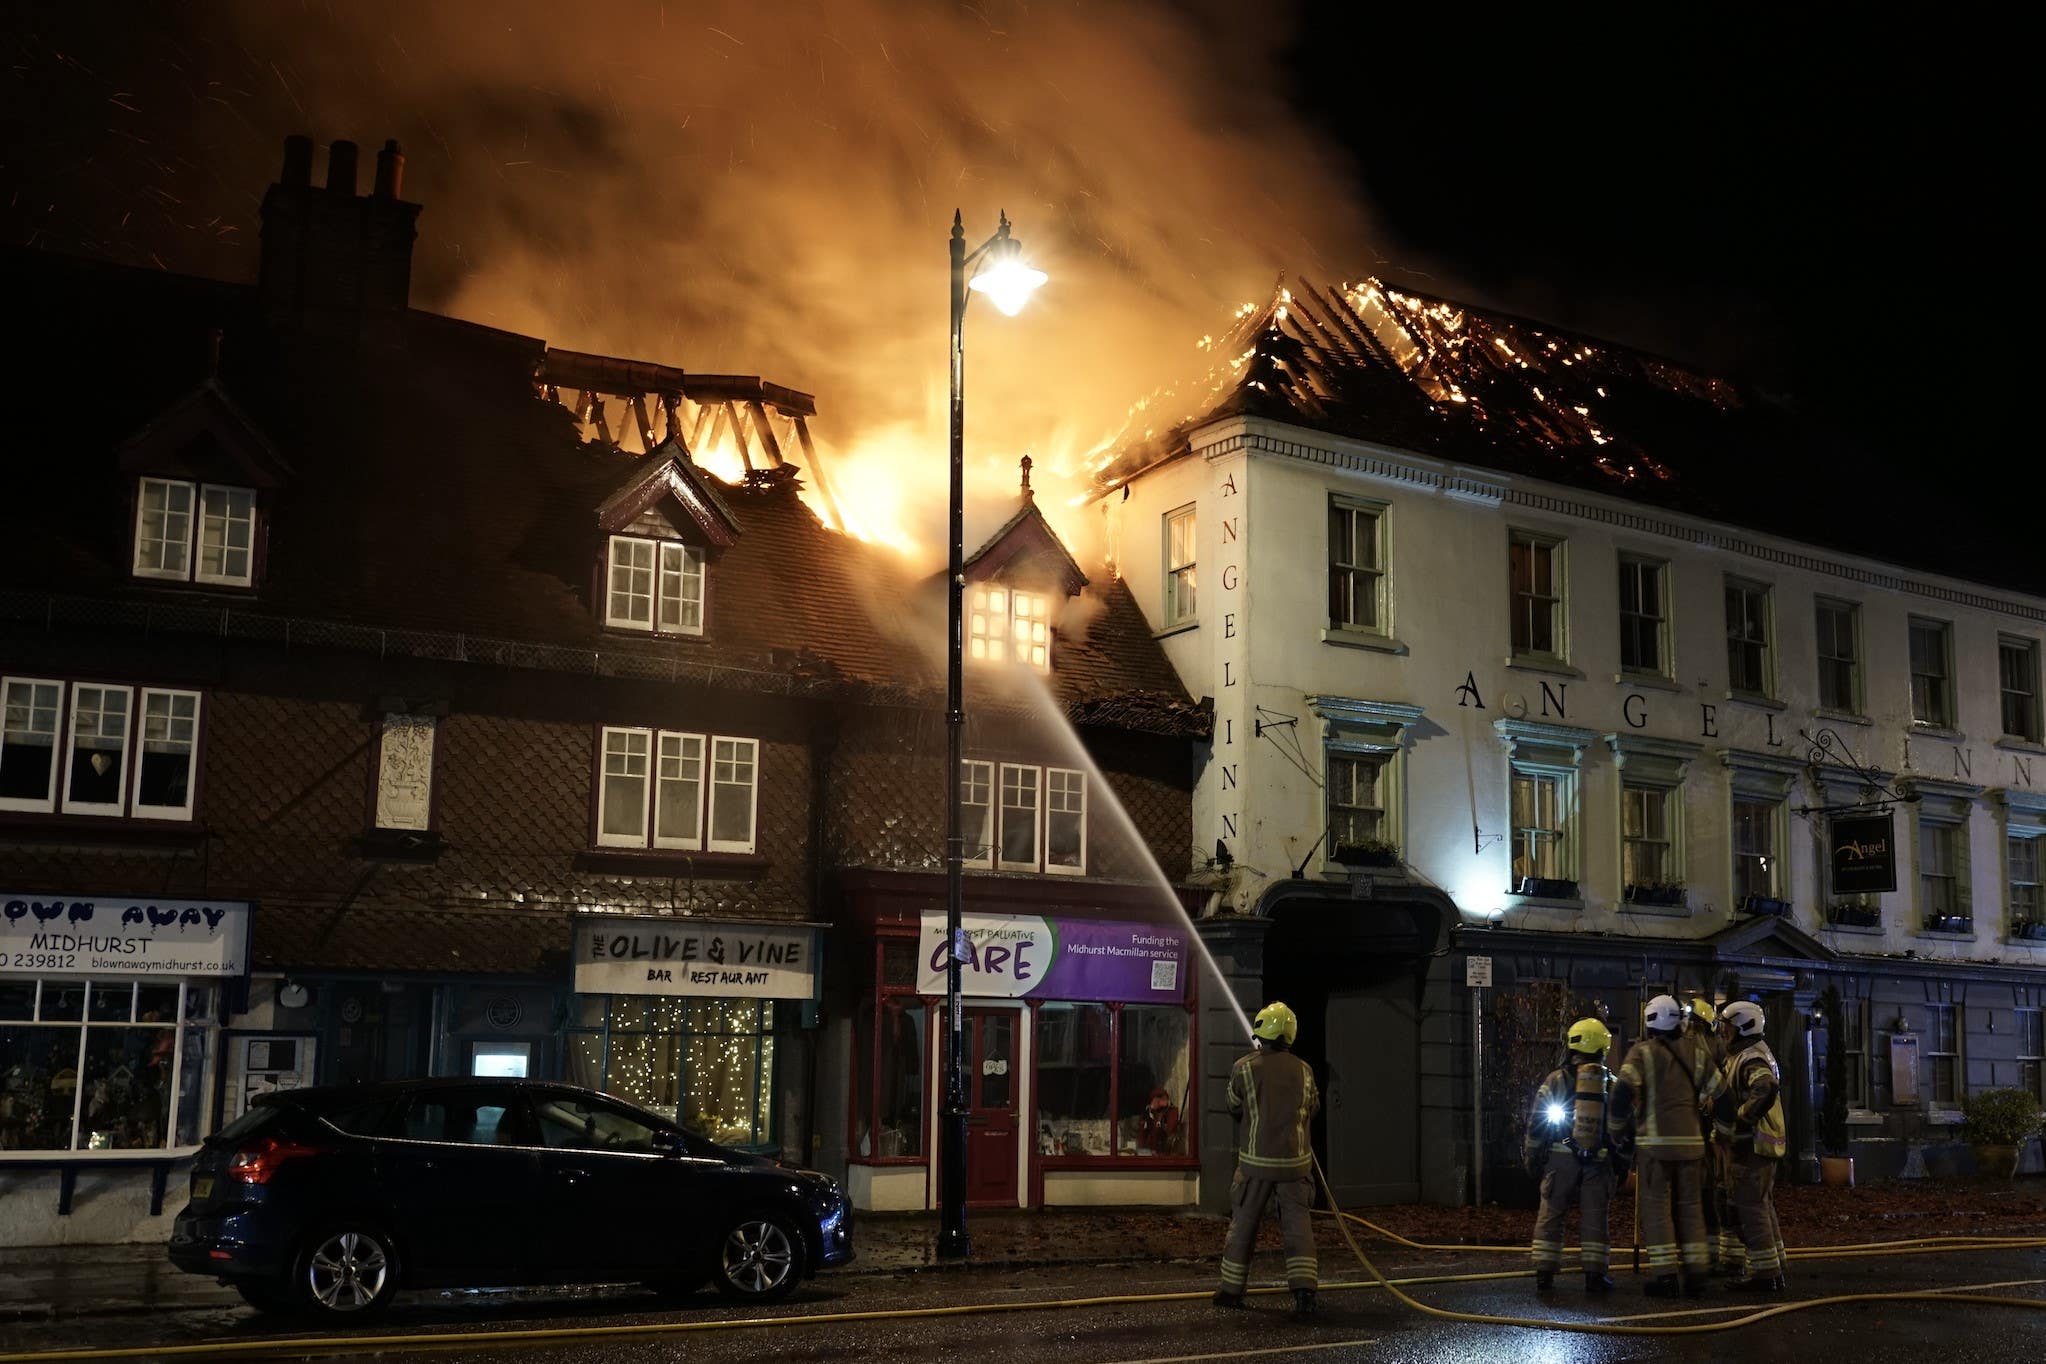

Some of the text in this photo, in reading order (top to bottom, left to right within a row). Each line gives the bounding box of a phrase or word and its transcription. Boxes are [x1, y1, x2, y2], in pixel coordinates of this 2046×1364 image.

[1222, 471, 1238, 840] ANGEL INN
[1455, 670, 2031, 787] ANGEL INN
[1834, 838, 1886, 860] Angel
[0, 899, 225, 929] OWN AWAY
[30, 933, 152, 953] MIDHURST
[593, 934, 605, 958] THE
[609, 935, 801, 965] OLIVE & VINE
[1067, 943, 1179, 959] Midhurst Macmillan service
[1132, 934, 1180, 947] Funding the
[14, 953, 75, 968] 239812
[91, 958, 235, 972] blownawaymidhurst.co.uk
[647, 968, 769, 985] BAR RESTAURANT
